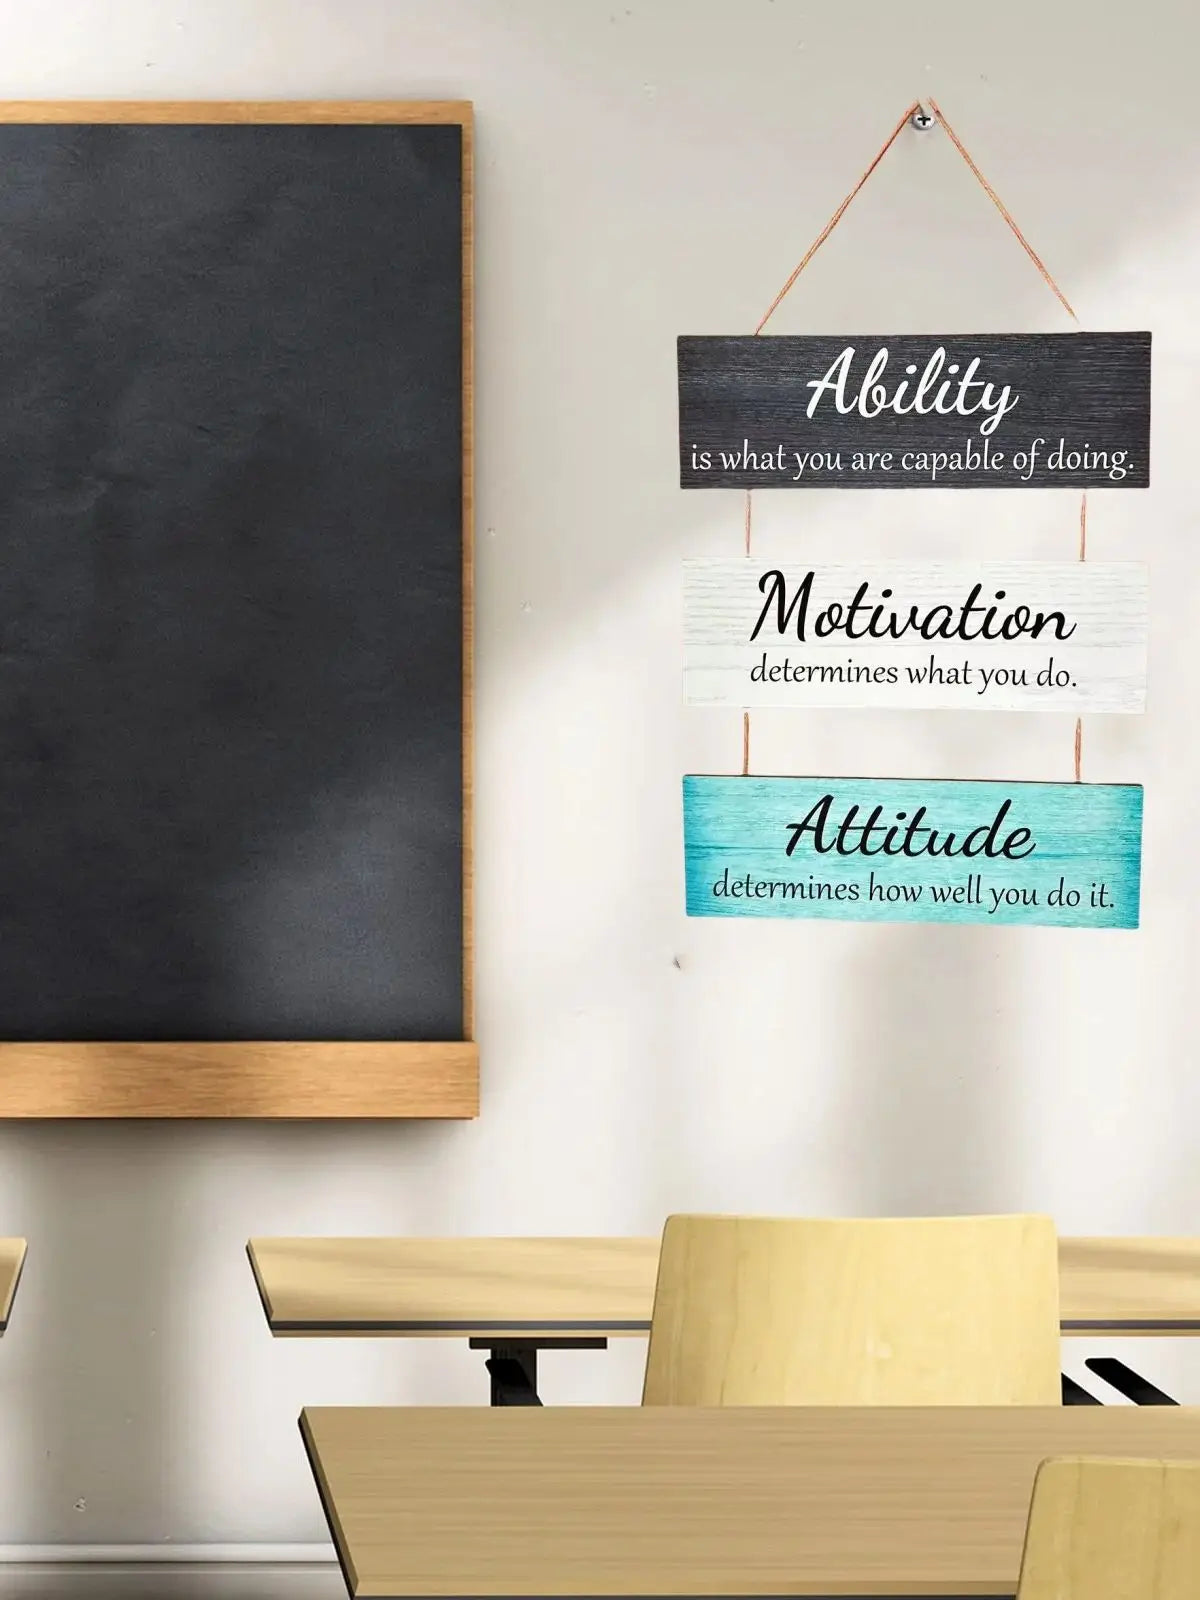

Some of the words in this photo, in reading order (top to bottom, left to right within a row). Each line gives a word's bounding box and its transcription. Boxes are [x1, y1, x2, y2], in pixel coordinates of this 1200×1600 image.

[806, 346, 1020, 436] Ability
[692, 443, 712, 470] is
[718, 438, 787, 471] what
[792, 452, 844, 481] you
[851, 452, 893, 471] are
[901, 438, 1005, 481] capable
[1012, 437, 1046, 481] of
[1047, 437, 1134, 480] doing.
[749, 569, 1078, 642] Motivation
[750, 652, 898, 684] determines
[905, 654, 973, 685] what
[977, 668, 1029, 695] you
[1036, 656, 1077, 687] do.
[785, 794, 1037, 860] Attitude
[712, 867, 860, 901] determines
[869, 871, 923, 902] how
[929, 874, 981, 904] well
[988, 888, 1039, 914] you
[1047, 876, 1081, 907] do
[1090, 882, 1114, 908] it.
